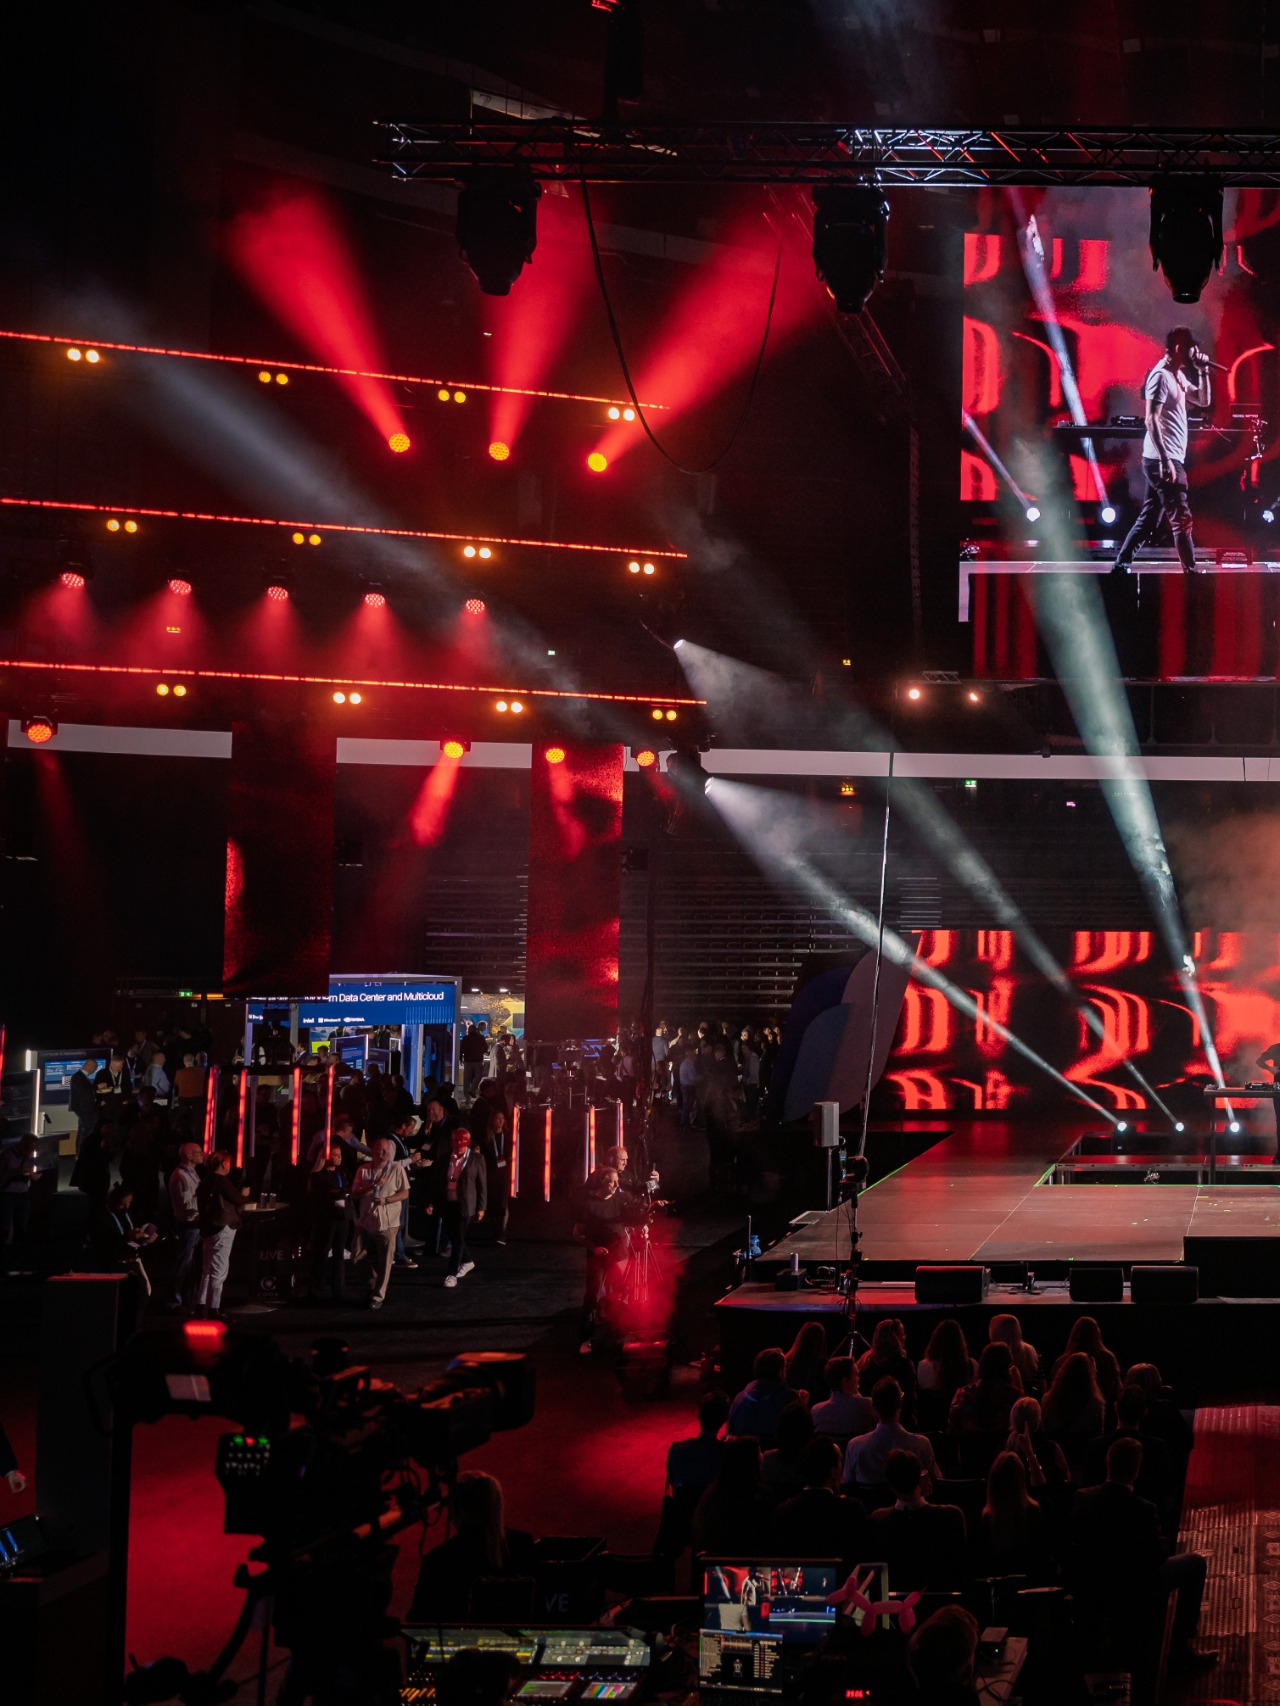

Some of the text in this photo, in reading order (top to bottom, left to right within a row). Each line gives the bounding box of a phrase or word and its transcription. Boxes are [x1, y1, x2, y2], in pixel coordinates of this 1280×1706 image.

[339, 993, 358, 1003] Data
[359, 993, 387, 1002] Center
[387, 992, 404, 1001] and
[404, 991, 444, 1001] Multicloud
[544, 1592, 569, 1614] VE
